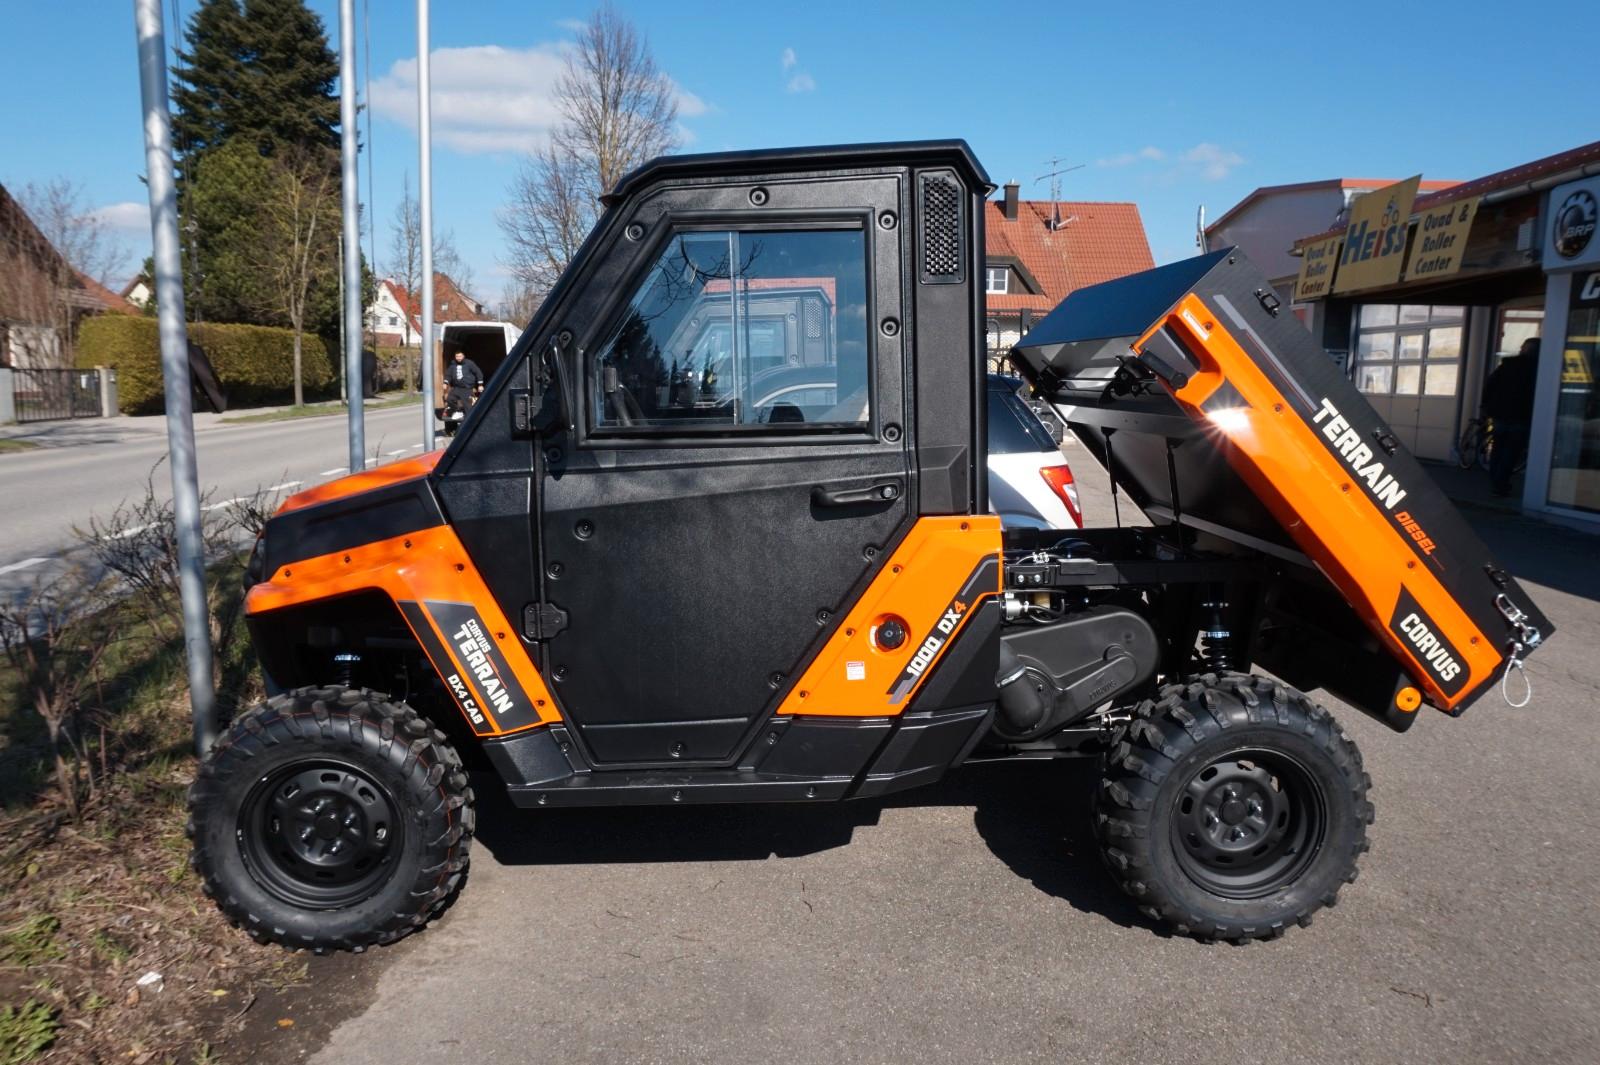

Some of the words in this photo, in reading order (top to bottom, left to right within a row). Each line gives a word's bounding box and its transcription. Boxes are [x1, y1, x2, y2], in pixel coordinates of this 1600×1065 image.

[1424, 206, 1455, 232] Quad
[1459, 203, 1470, 222] &
[1567, 223, 1595, 237] BRP
[1306, 243, 1326, 262] Quad
[1421, 232, 1457, 253] Roller
[1305, 261, 1328, 278] Roller
[1415, 256, 1453, 275] Center
[1301, 280, 1325, 295] Center
[1312, 397, 1407, 510] TERRAIN
[1394, 510, 1437, 555] DIESEL
[466, 619, 492, 653] CORVUS
[906, 635, 941, 677] 1000
[937, 600, 967, 635] DX4
[1399, 612, 1461, 682] CORVUS
[453, 623, 514, 714] TERRAIN
[447, 674, 468, 699] DX4
[462, 699, 484, 725] CAB
